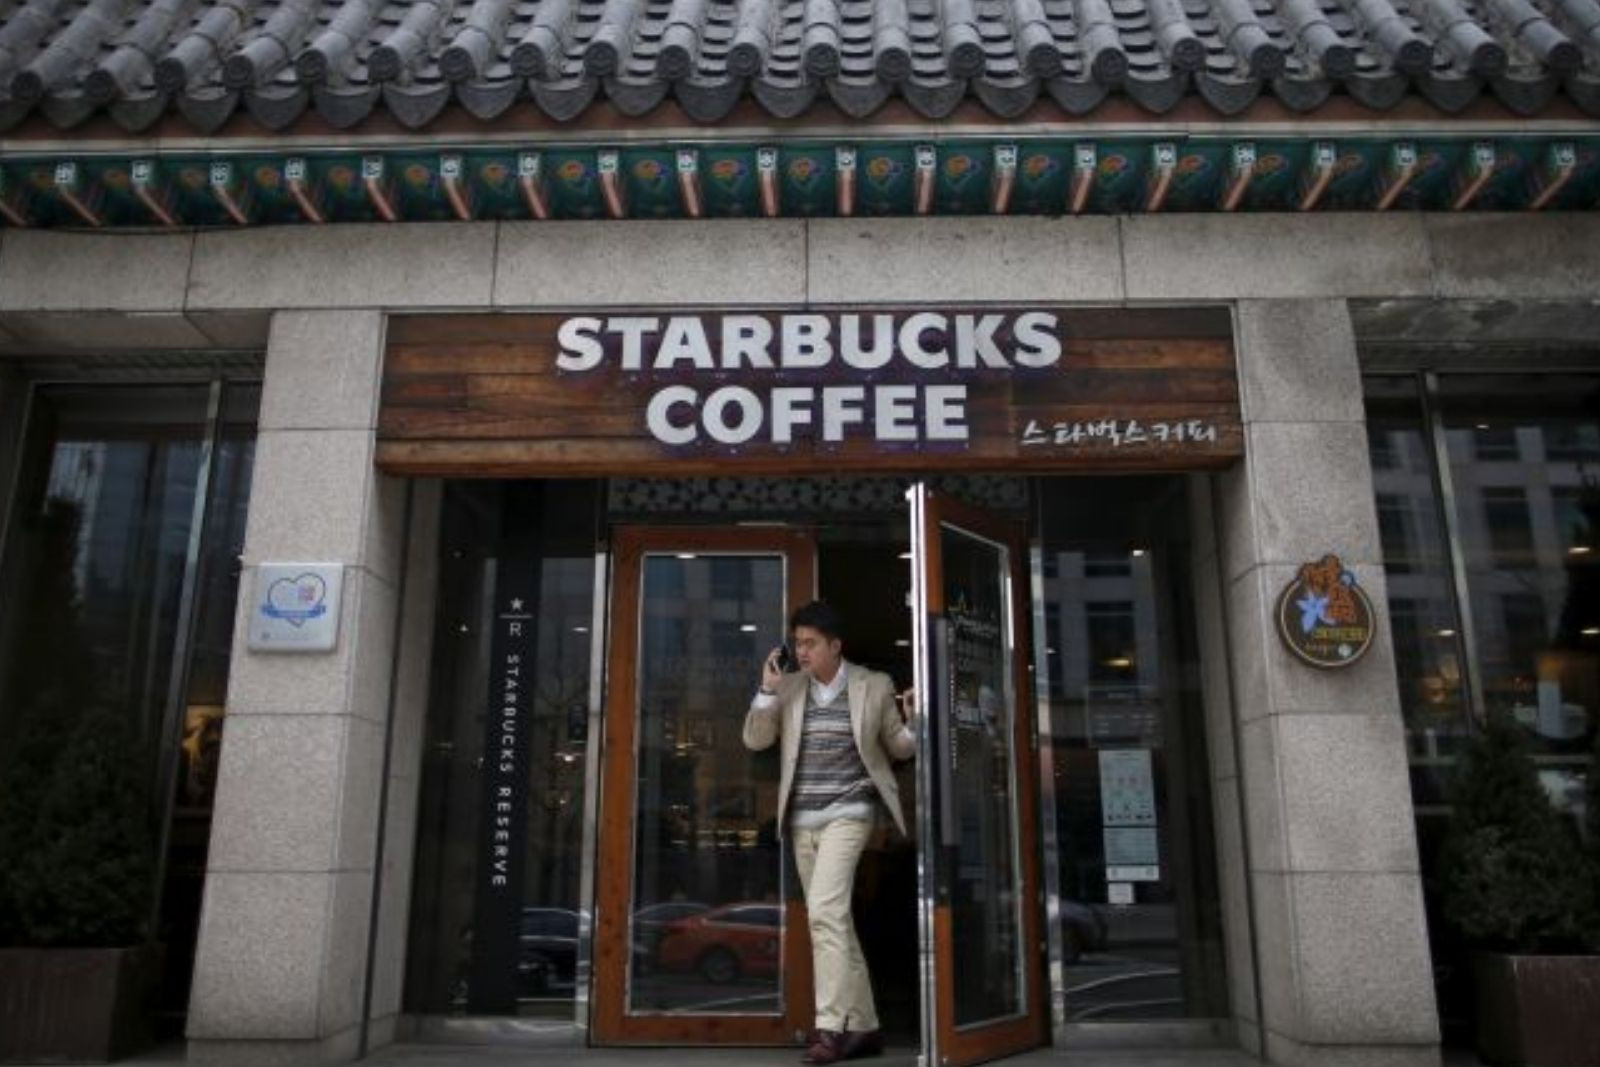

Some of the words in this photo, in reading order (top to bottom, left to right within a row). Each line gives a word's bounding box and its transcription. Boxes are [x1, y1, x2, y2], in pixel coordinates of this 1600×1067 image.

[555, 312, 1062, 372] STARBUCKS
[646, 384, 970, 445] COFFEE
[500, 653, 520, 773] STARBUCKS
[492, 786, 512, 886] RESERVE
